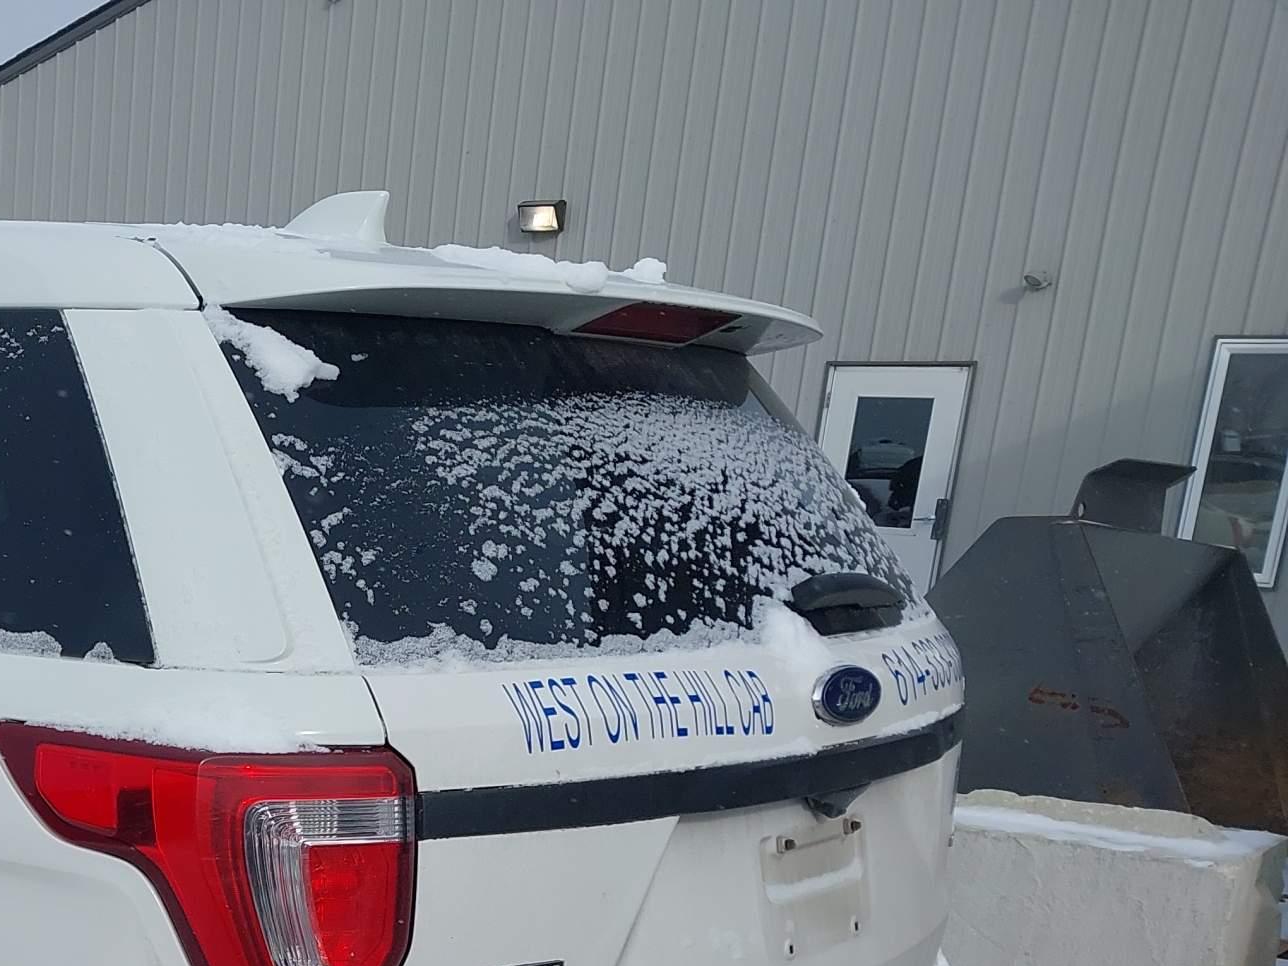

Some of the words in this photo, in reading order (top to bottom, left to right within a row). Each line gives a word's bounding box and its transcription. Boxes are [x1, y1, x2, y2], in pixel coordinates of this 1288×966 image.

[501, 677, 593, 755] WEST
[587, 673, 640, 744] ON
[623, 671, 689, 740] THE
[672, 670, 735, 737] HILL
[724, 669, 774, 737] CAB
